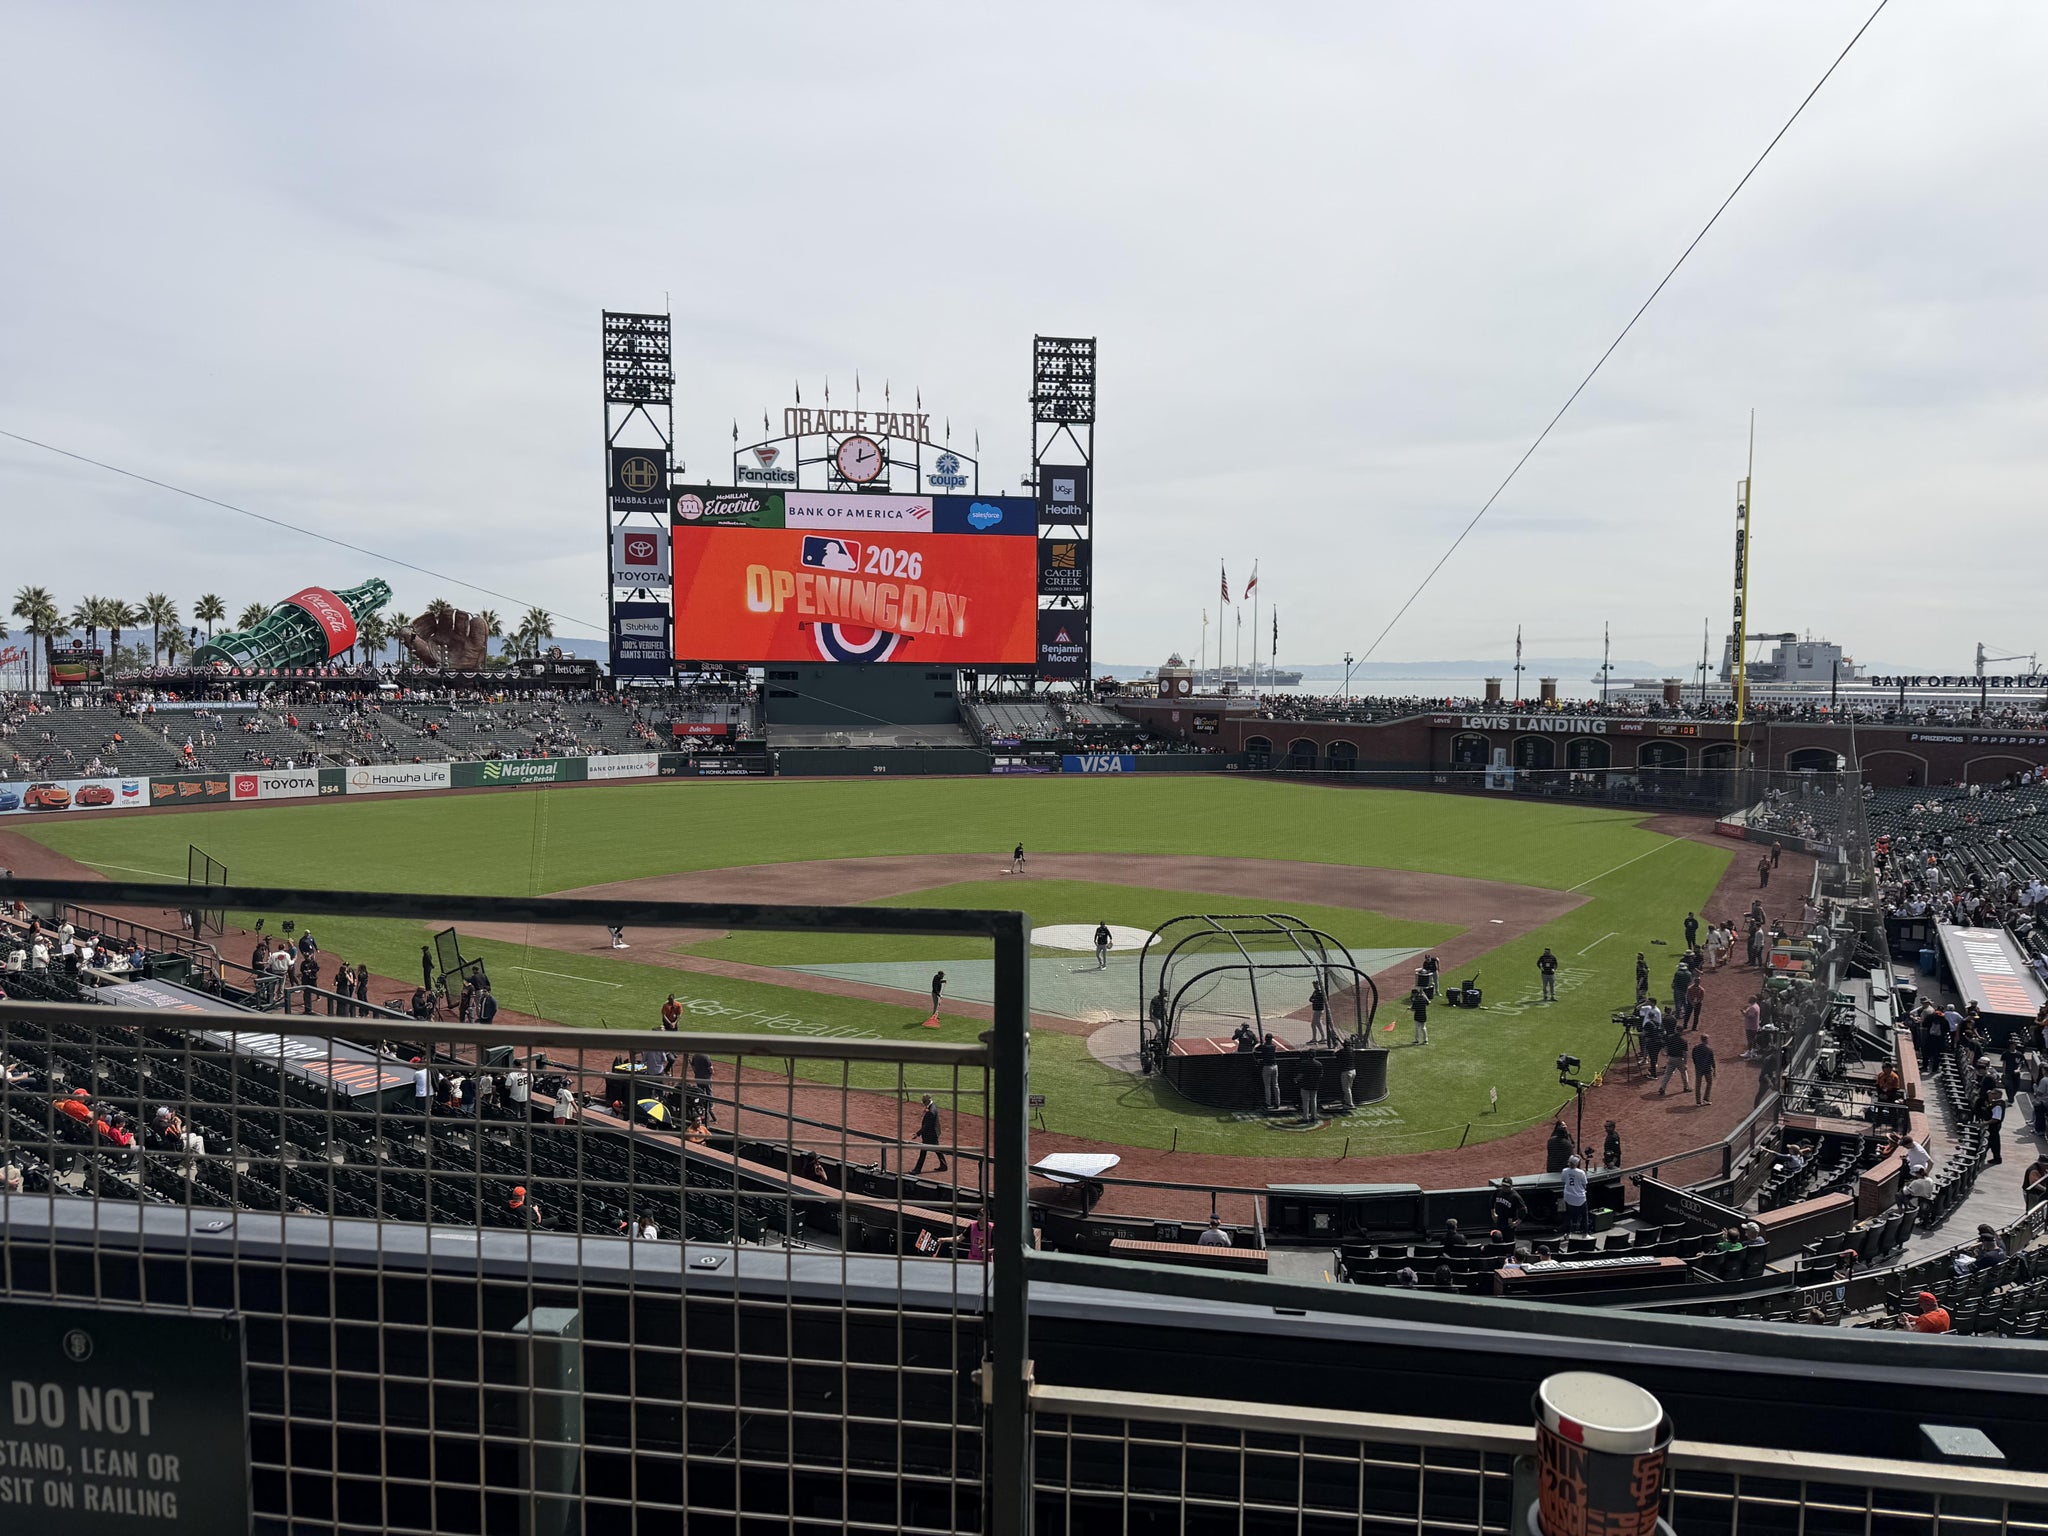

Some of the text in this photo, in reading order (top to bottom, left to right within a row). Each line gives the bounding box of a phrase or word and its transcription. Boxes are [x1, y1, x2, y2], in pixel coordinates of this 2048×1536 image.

[784, 408, 931, 444] ORACLE PARK
[738, 468, 795, 482] Fanatics
[930, 475, 966, 488] coupa
[1054, 485, 1073, 495] UCSF
[615, 496, 666, 505] HABBAS LAW
[704, 498, 761, 516] Electric
[789, 507, 903, 519] BANK OF AMERICA
[1045, 504, 1082, 515] Health
[972, 512, 1000, 520] salesforce
[864, 545, 922, 580] 2026
[617, 571, 666, 582] TOYOTA
[1045, 569, 1082, 577] CACHE
[1046, 578, 1081, 586] CREEK
[746, 564, 968, 637] OPENING DAY
[626, 623, 658, 631] StubHub
[622, 641, 664, 650] 100% VERIFIED
[1042, 644, 1083, 655] Benjamin
[620, 650, 666, 660] GIANTS TICKETS
[1048, 654, 1077, 662] Moore
[1872, 676, 1921, 687] BANK
[1928, 676, 1954, 687] OF
[1516, 718, 1607, 733] LANDING
[1920, 735, 1964, 743] PRIZEPICKS
[502, 762, 557, 776] National
[1077, 755, 1122, 772] VISA
[661, 767, 676, 775] 399
[263, 778, 314, 790] TOYOTA
[372, 772, 445, 784] Hanwha Life
[321, 785, 339, 793] 354
[1527, 1255, 1655, 1271] Audi Dugout Club
[1803, 1289, 1833, 1307] blue
[11, 1380, 154, 1437] DO NOT
[81, 1446, 138, 1479] LEAN
[148, 1453, 181, 1483] OR
[0, 1475, 178, 1519] SIT ON RAILING
